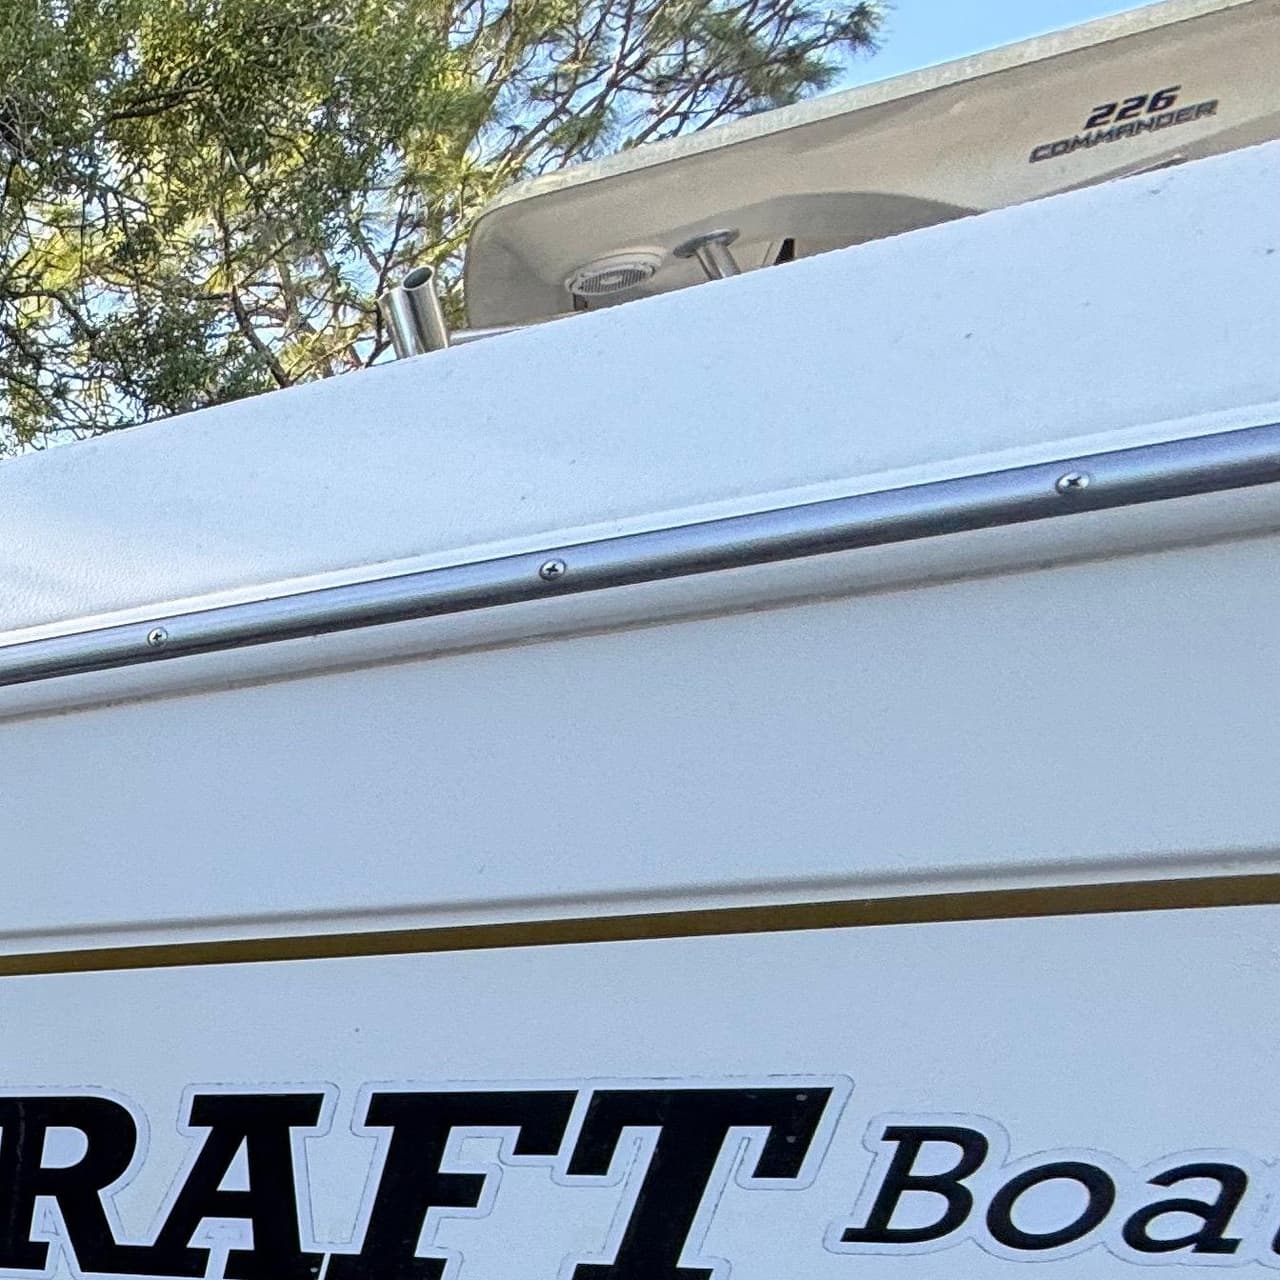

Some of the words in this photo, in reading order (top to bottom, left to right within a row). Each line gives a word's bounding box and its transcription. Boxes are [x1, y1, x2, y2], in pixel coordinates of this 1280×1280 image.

[1028, 99, 1219, 163] COMMANDER
[1082, 84, 1182, 130] 226
[840, 1125, 1280, 1256] Boa
